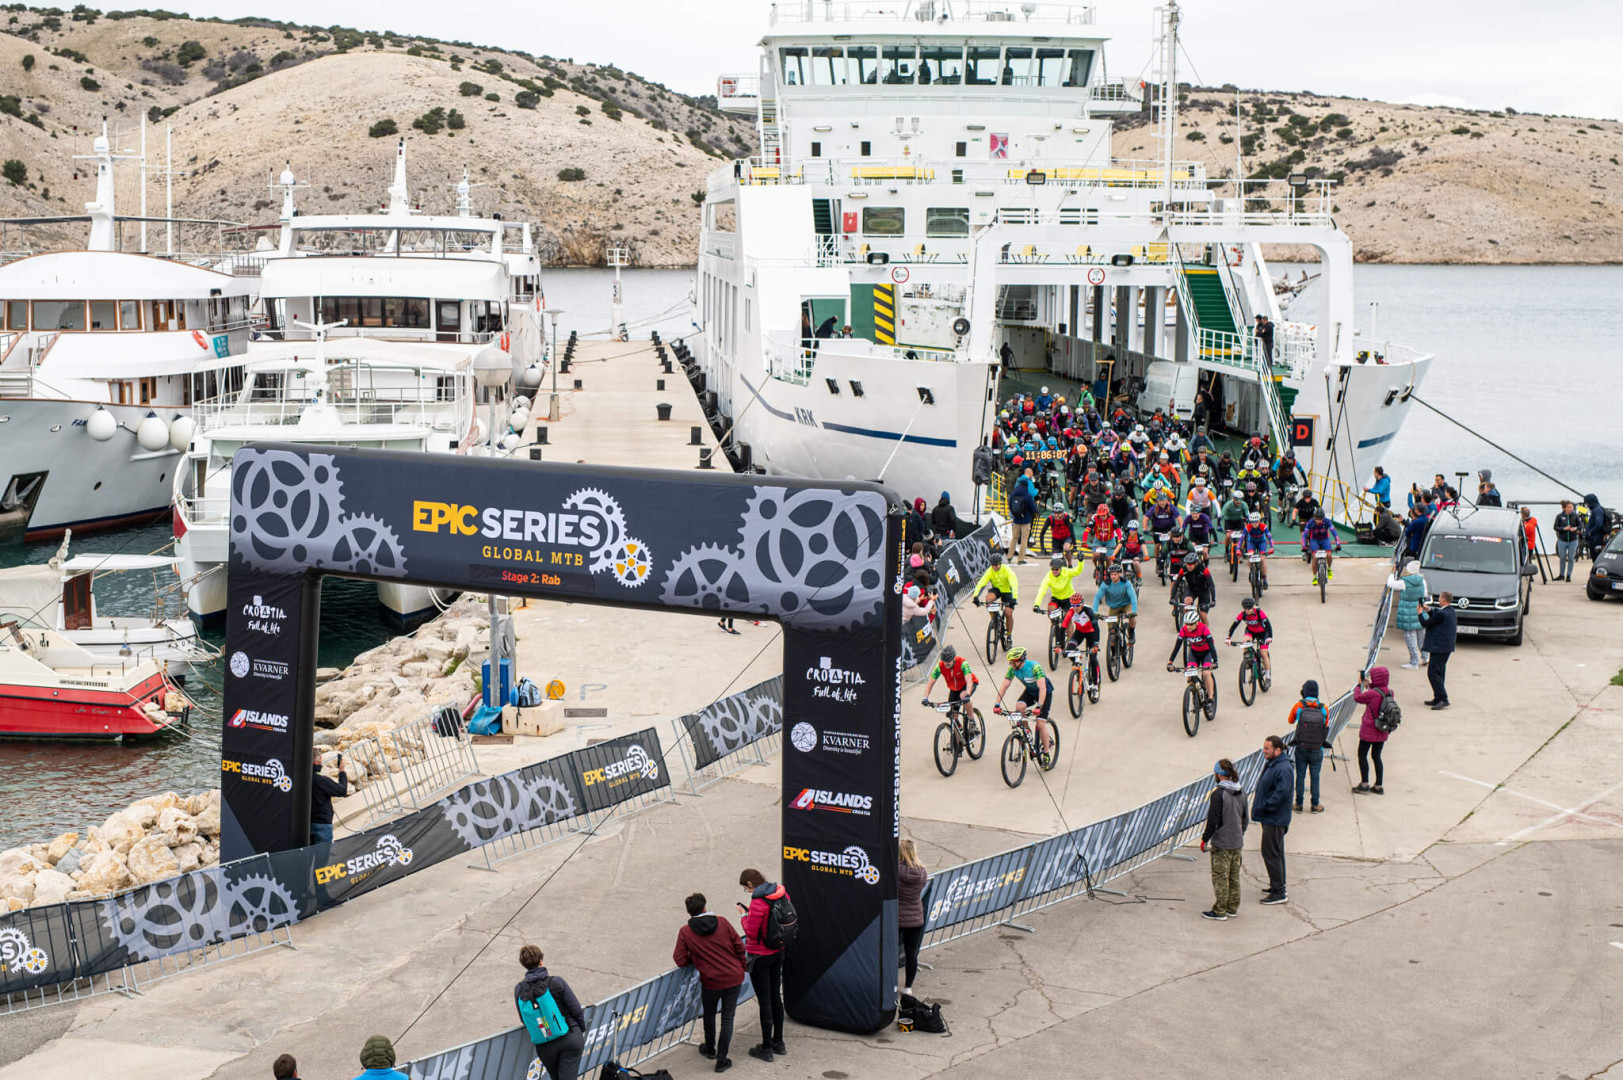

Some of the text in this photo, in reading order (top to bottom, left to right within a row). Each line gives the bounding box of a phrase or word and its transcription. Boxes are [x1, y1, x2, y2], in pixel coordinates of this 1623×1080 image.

[794, 406, 818, 428] KRK
[1296, 424, 1309, 440] D
[1025, 450, 1067, 460] 11:06:07
[413, 500, 600, 547] EPIC SERIES
[482, 545, 583, 567] GLOBAL MTB
[502, 570, 561, 586] Stage 2: Rab
[243, 604, 287, 619] CROATIA
[253, 662, 289, 675] KVARNER
[806, 667, 866, 684] CROATIA
[813, 685, 830, 698] Full
[843, 688, 857, 703] life
[822, 735, 870, 749] KVARNER
[893, 656, 902, 838] www.epic-series.com
[222, 760, 278, 779] EPIC SERIES
[583, 755, 642, 786] EPIC SERIES
[241, 775, 261, 783] GLOBAL
[315, 847, 394, 885] EPIC SERIES
[783, 846, 859, 869] EPIC SERIES
[811, 865, 837, 874] GLOBAL
